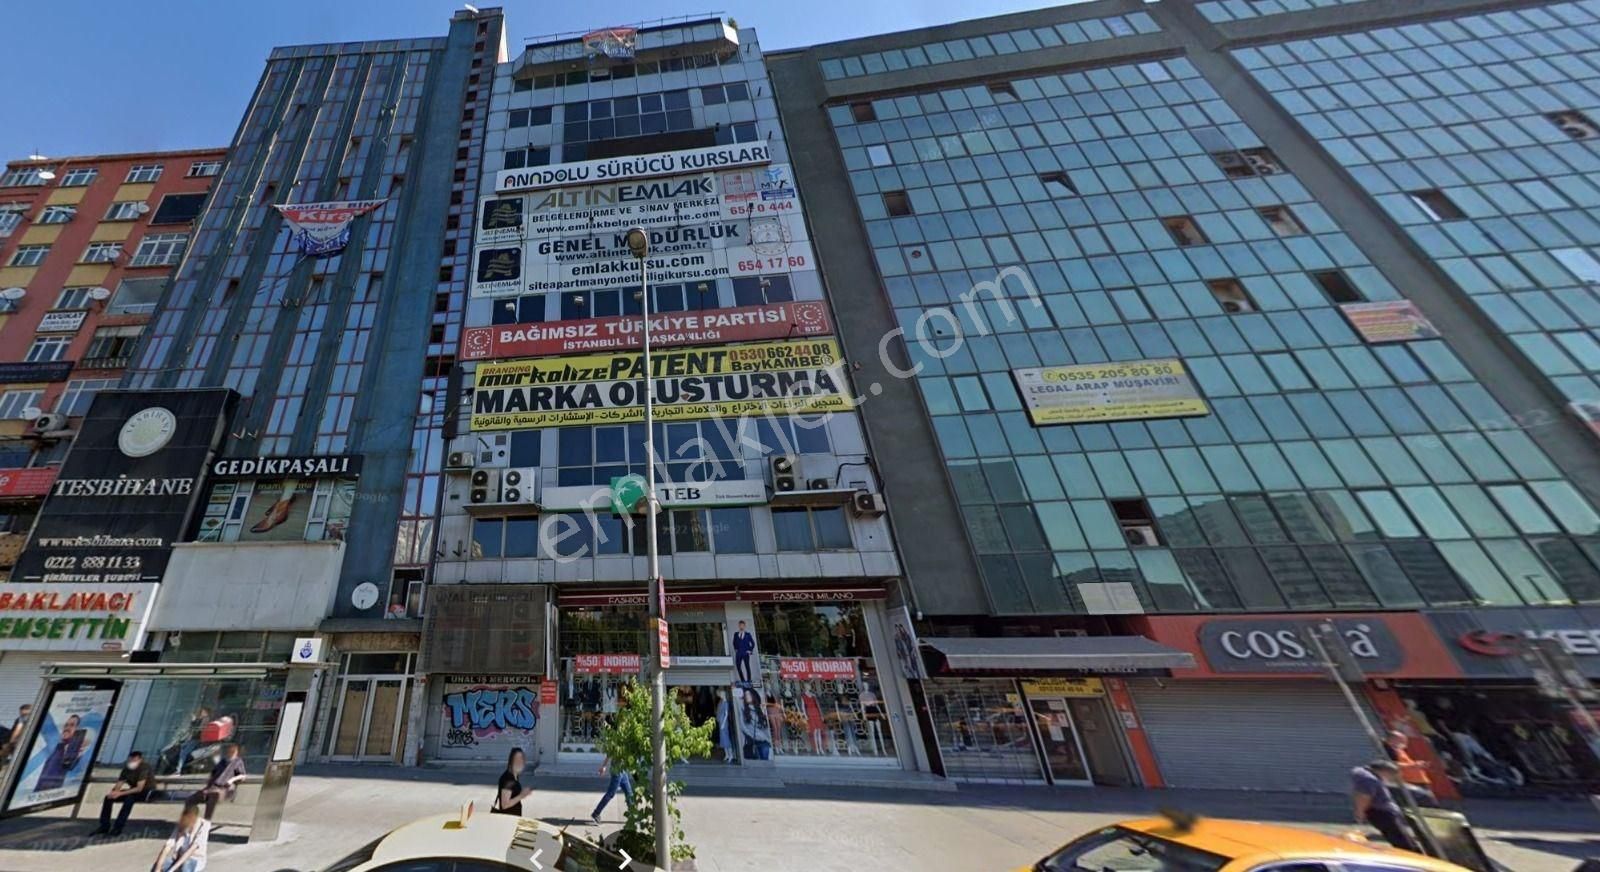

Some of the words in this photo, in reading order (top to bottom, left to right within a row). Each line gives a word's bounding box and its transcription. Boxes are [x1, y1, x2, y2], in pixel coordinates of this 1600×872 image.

[597, 154, 675, 178] SÜRÜCÜ
[681, 146, 769, 169] KURSLARI
[534, 177, 714, 210] ALTINEMLAK
[769, 201, 793, 211] 444
[536, 210, 720, 234] www.emlakbelgelendirme.com
[538, 236, 606, 255] GENEL
[614, 221, 739, 248] MDÜRLÜK
[555, 240, 707, 261] www.altinek.com.tr
[571, 255, 705, 276] emlakkusu.com
[738, 260, 763, 272] 654
[767, 257, 783, 269] 17
[788, 255, 805, 267] 60
[500, 324, 598, 344] BAĞIMSIZ
[604, 316, 699, 336] TÜRKİYE
[703, 306, 787, 328] PARTİSİ
[563, 337, 624, 350] İSTANBUL
[627, 336, 639, 346] İL
[648, 330, 721, 344] AŞKANLIĞI
[482, 365, 532, 375] BRANDING
[610, 350, 728, 380] PATENT
[1058, 371, 1096, 382] 0535
[1099, 369, 1128, 380] 205
[1130, 367, 1150, 378] 80
[1153, 365, 1174, 376] 80
[1029, 384, 1073, 395] LEGAL
[1075, 381, 1110, 392] ARAP
[475, 383, 604, 414] MARKA
[213, 456, 349, 476] GEDİKPAŞALI
[53, 473, 193, 497] TESBİHANE
[660, 487, 701, 500] TEB
[44, 556, 77, 569] 0212
[773, 592, 814, 601] FASHION
[816, 592, 854, 600] MILANO
